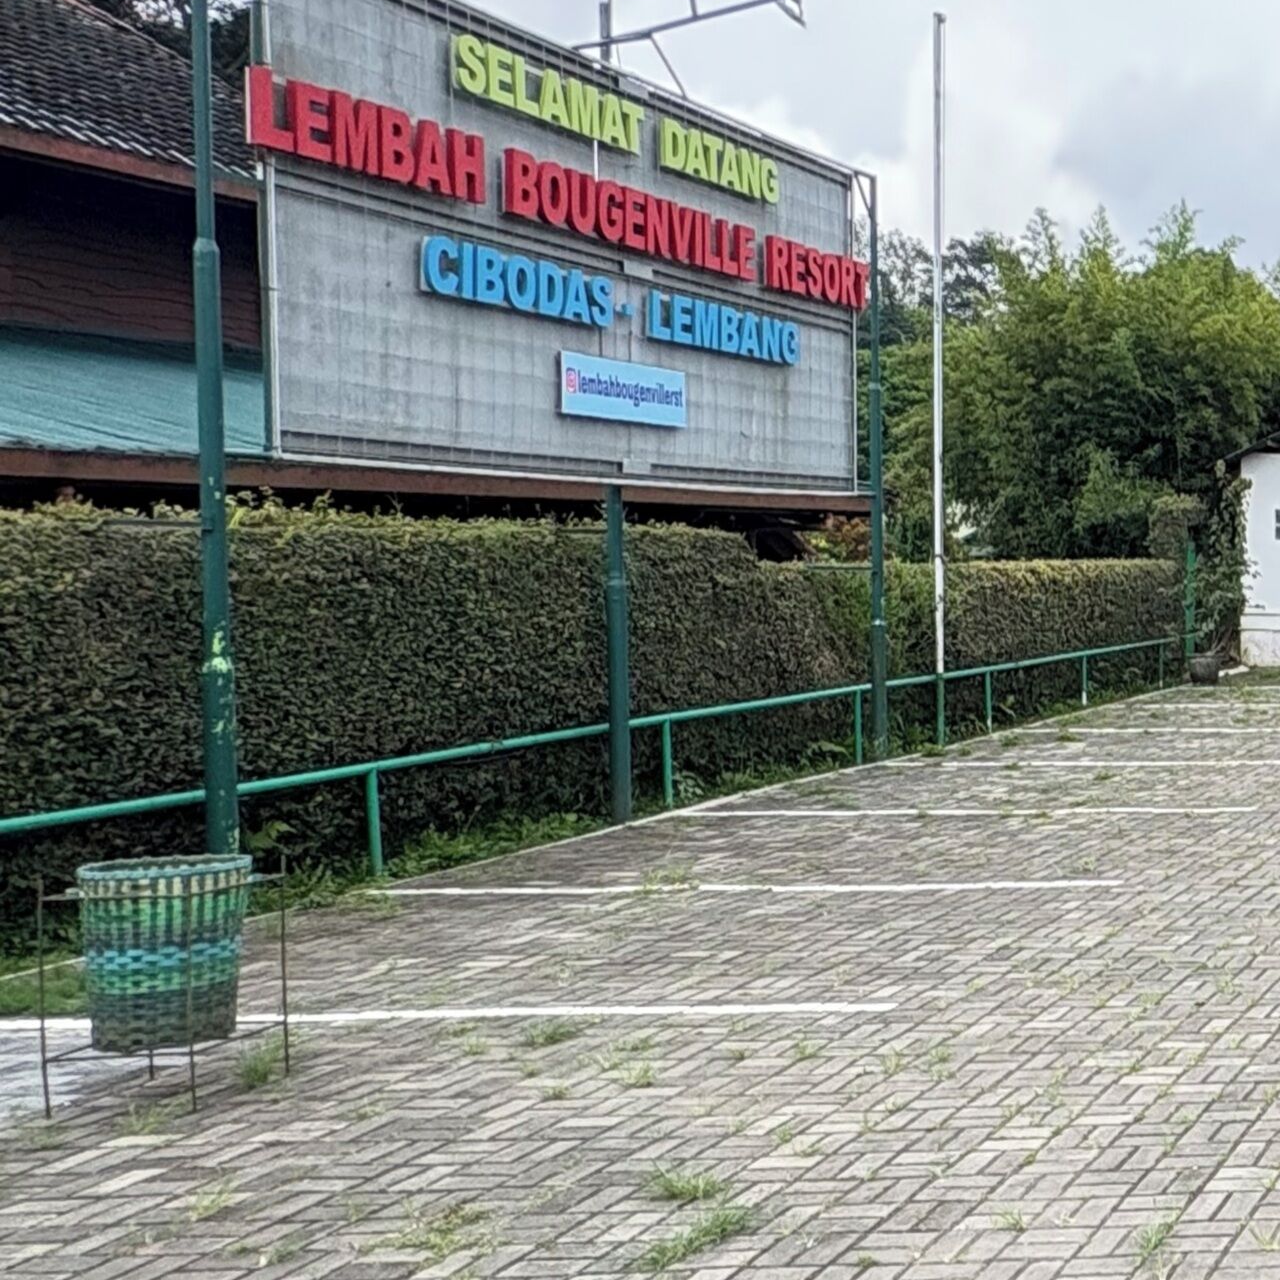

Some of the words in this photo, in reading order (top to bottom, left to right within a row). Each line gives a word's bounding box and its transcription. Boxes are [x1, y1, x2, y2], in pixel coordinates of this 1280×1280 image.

[247, 64, 486, 204] LEMBAH
[504, 148, 756, 282] BOUGENVILLE
[765, 235, 869, 311] RESORT
[455, 34, 644, 156] SELAMAT
[661, 117, 779, 204] DATANG
[423, 236, 614, 328] CIBODAS
[647, 289, 799, 366] LEMBANG
